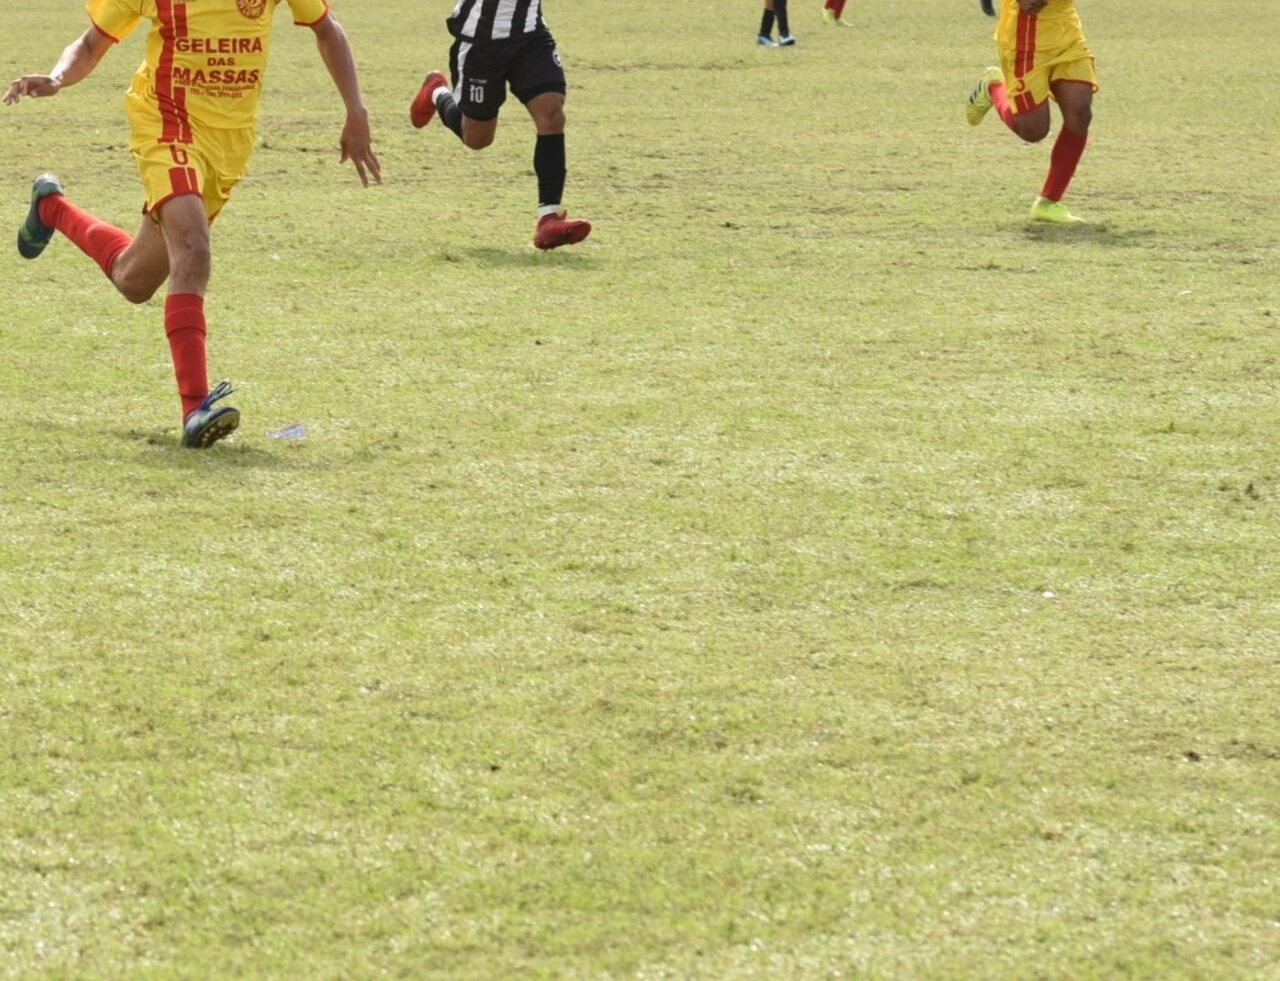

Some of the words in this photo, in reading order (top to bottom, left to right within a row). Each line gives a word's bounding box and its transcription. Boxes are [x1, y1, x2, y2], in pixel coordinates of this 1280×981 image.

[175, 37, 262, 53] GELEIRA
[207, 57, 235, 66] DAS
[173, 67, 259, 84] MASSAS
[470, 85, 484, 103] 10
